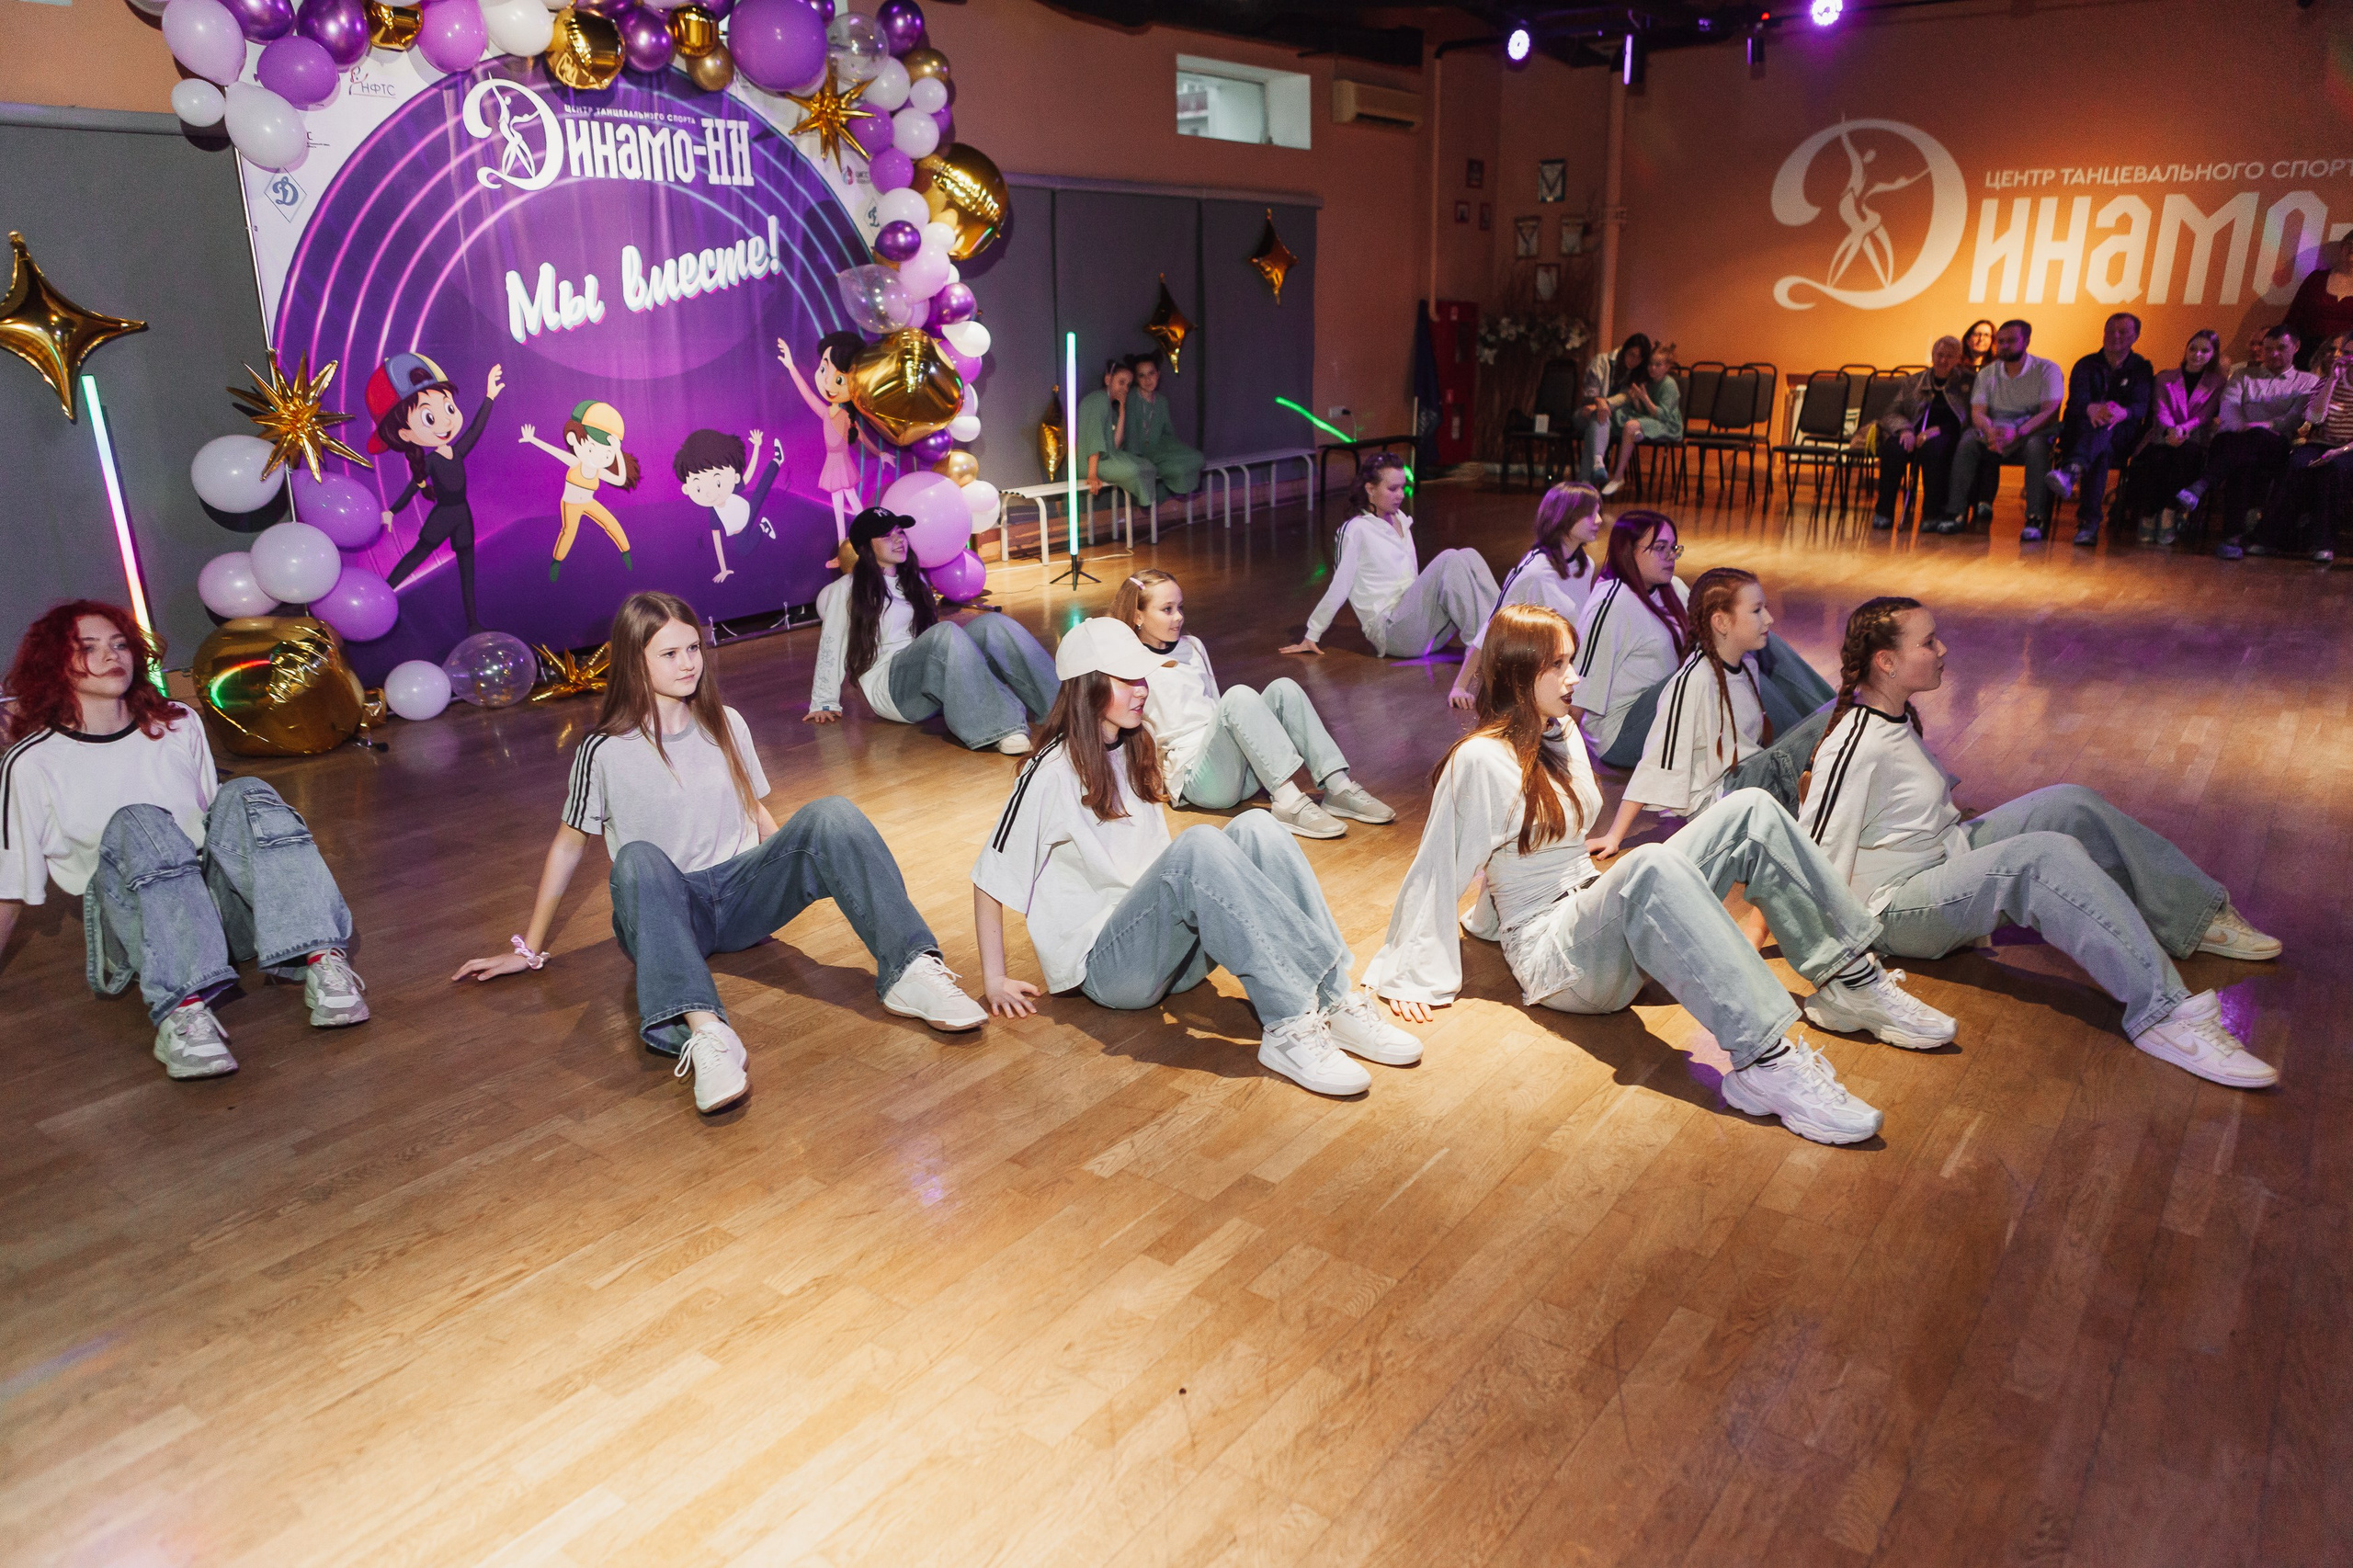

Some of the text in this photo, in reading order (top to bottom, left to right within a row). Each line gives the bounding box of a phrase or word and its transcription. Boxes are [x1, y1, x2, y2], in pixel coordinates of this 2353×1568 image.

[1984, 168, 2056, 189] ЦЕНТР
[2060, 161, 2265, 187] ТАНЦЕВАЛЬНОГО
[506, 215, 781, 346] Мы вместе!
